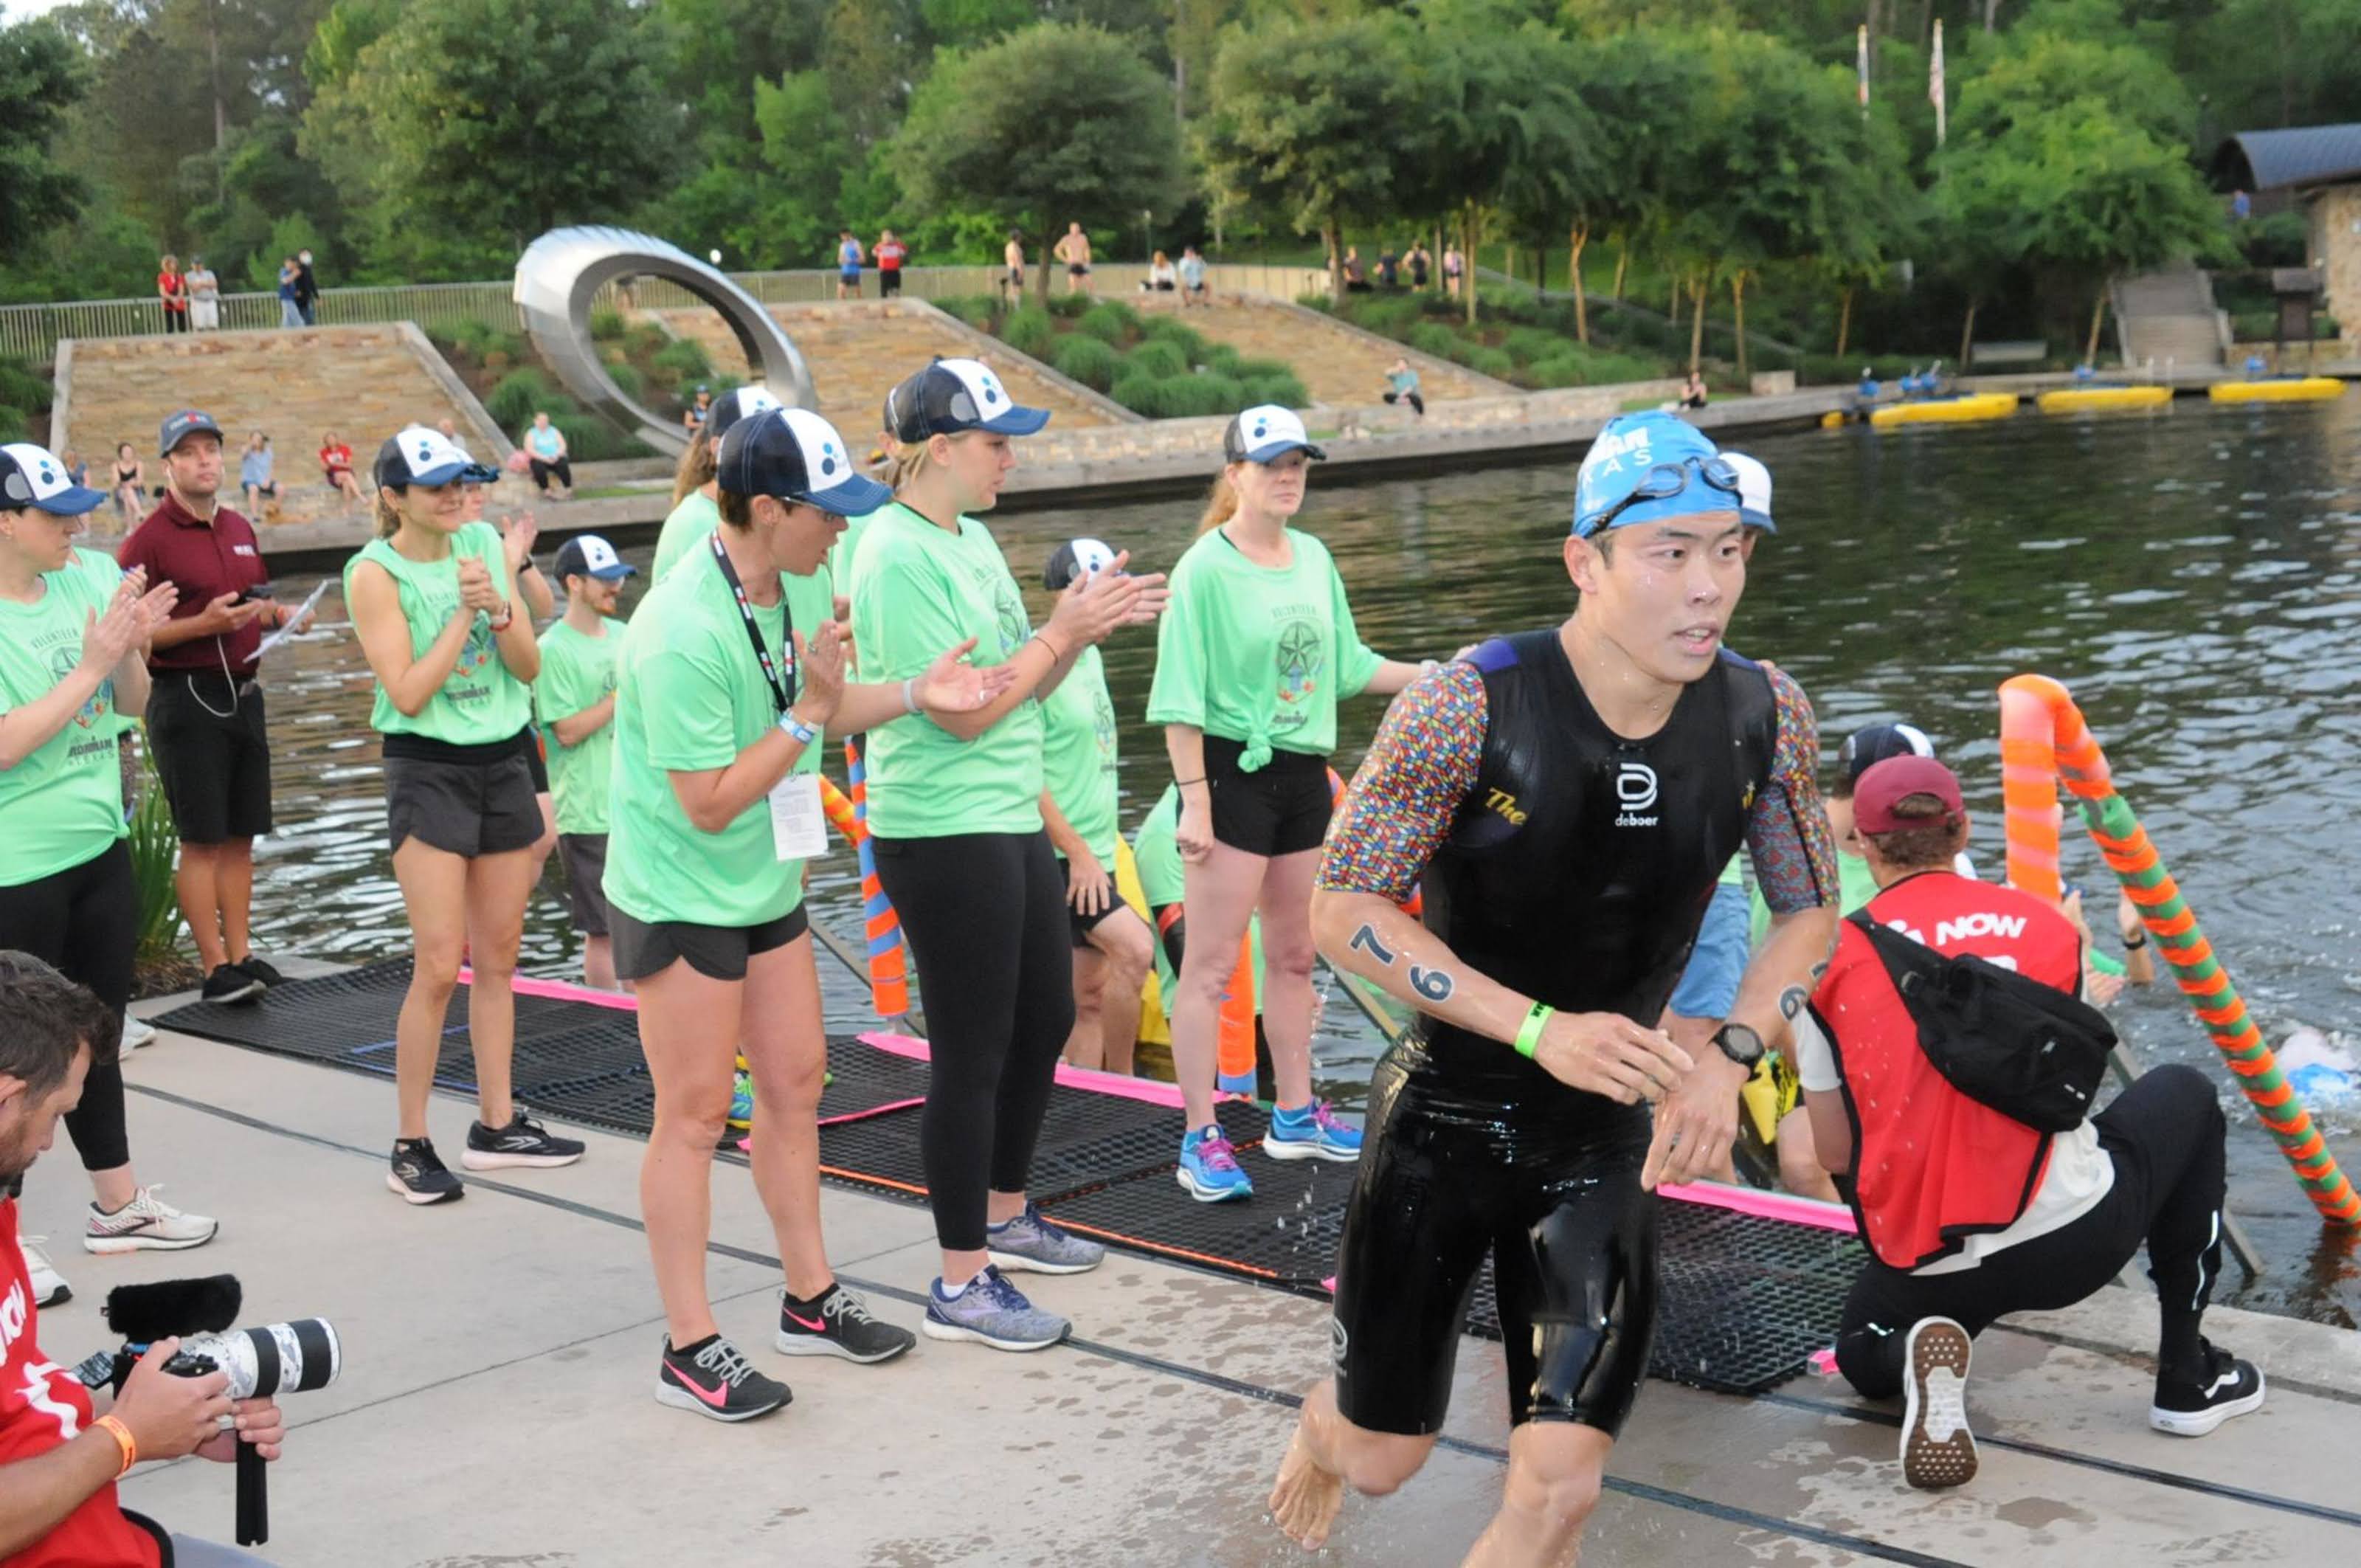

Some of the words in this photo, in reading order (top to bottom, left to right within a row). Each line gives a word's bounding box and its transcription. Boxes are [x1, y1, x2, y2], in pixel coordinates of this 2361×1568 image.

[1485, 786, 1527, 826] The
[1614, 812, 1659, 826] deboer
[1935, 912, 2028, 946] NOW
